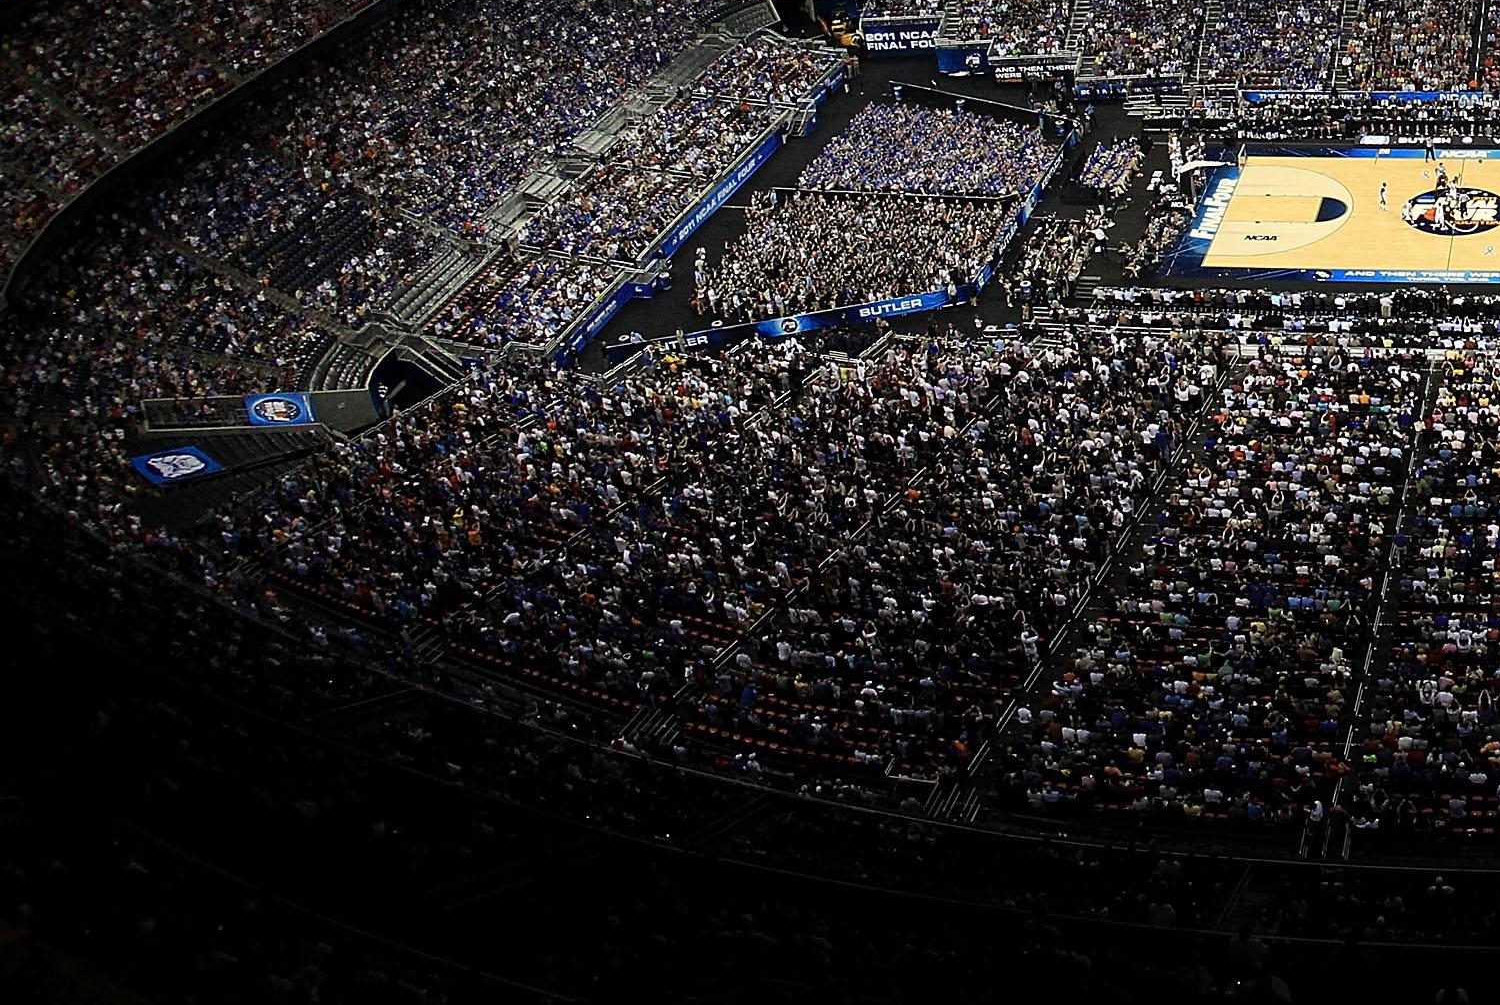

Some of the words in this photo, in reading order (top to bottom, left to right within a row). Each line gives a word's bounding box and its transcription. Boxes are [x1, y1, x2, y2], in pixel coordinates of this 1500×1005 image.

[866, 32, 896, 42] 2011
[867, 41, 907, 51] FINAL
[911, 39, 935, 49] FOU
[679, 221, 695, 241] 2011
[696, 199, 716, 223] NCAA
[717, 179, 737, 202] FINAL
[737, 158, 756, 181] FOUR
[859, 298, 923, 318] BUTLER
